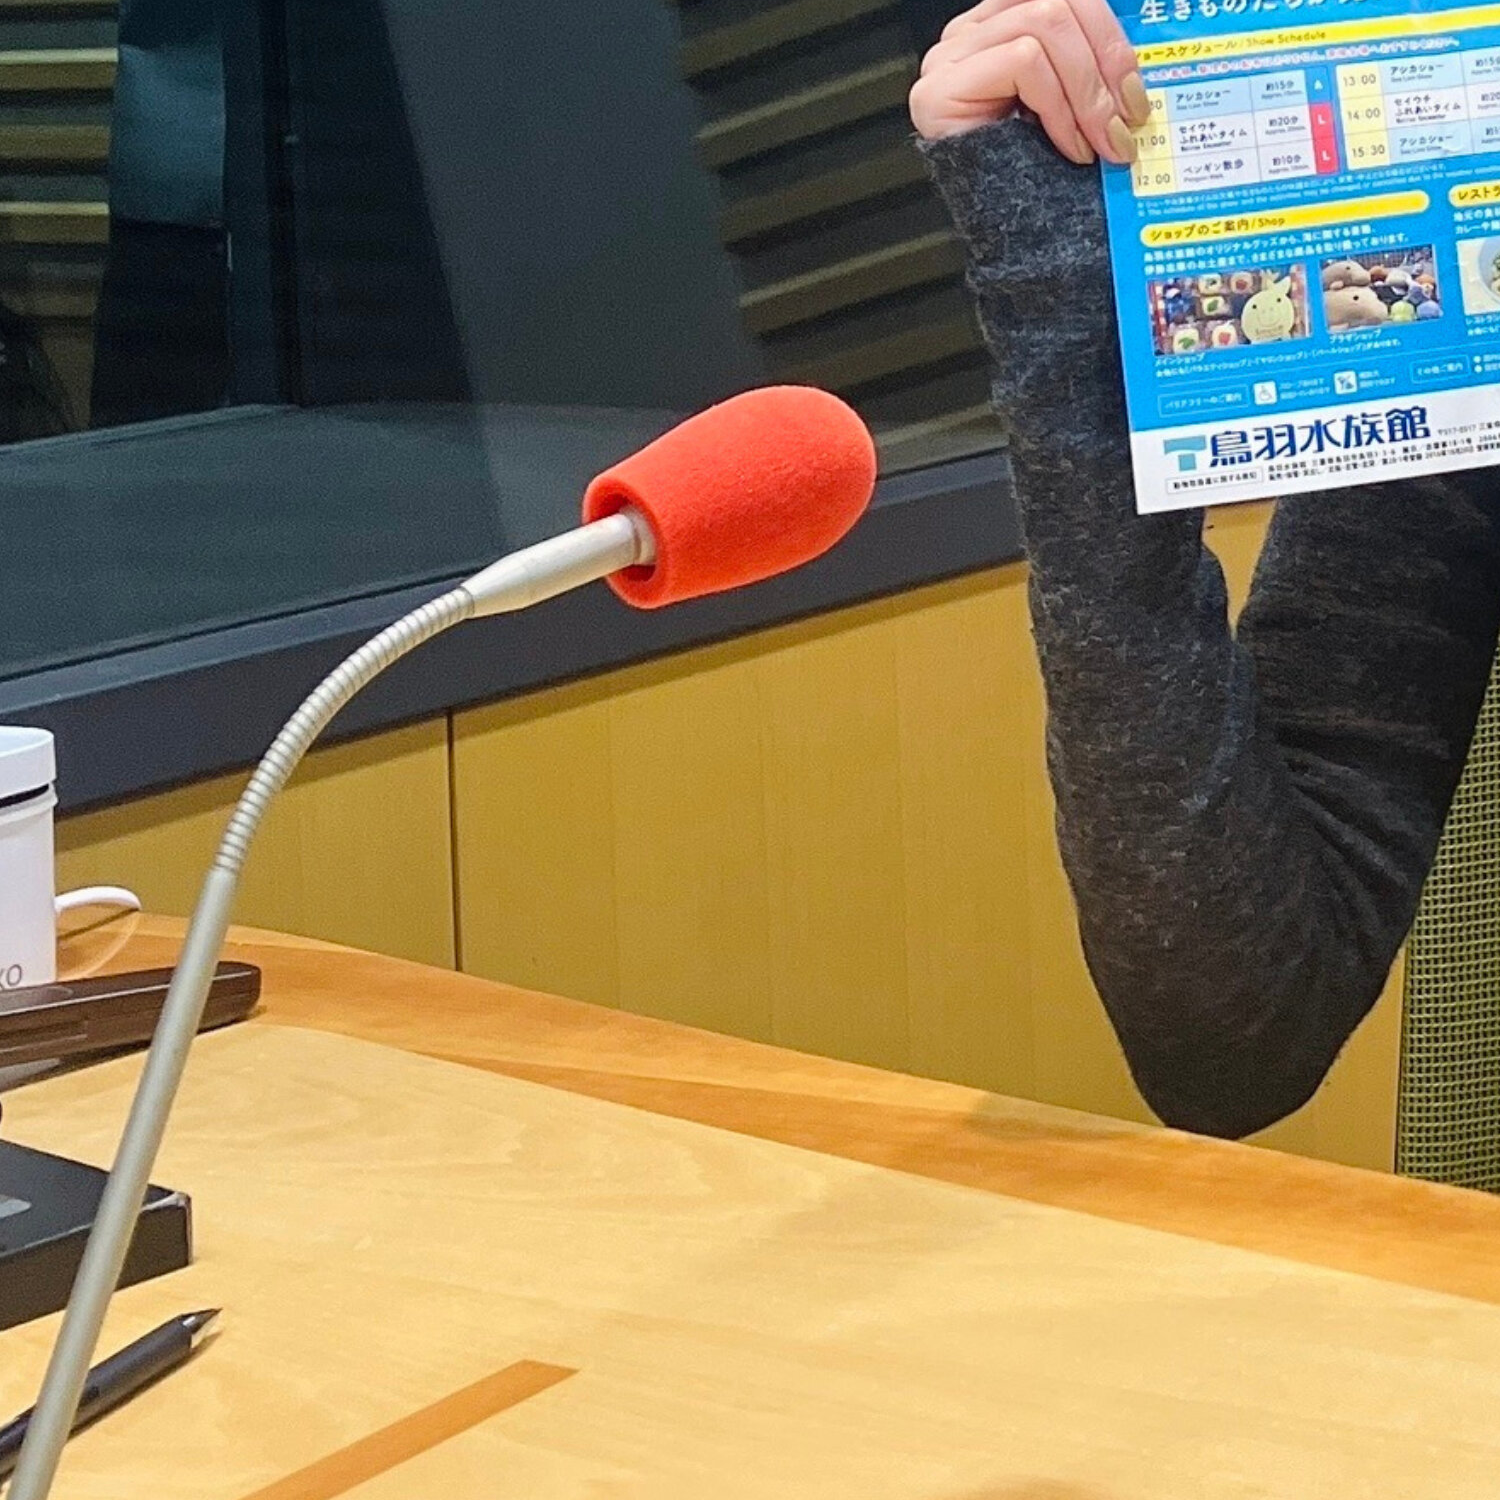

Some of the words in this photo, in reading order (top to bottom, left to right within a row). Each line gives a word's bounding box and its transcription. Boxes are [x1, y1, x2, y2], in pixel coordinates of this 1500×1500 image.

[1209, 406, 1432, 469] 鳥羽水族館
